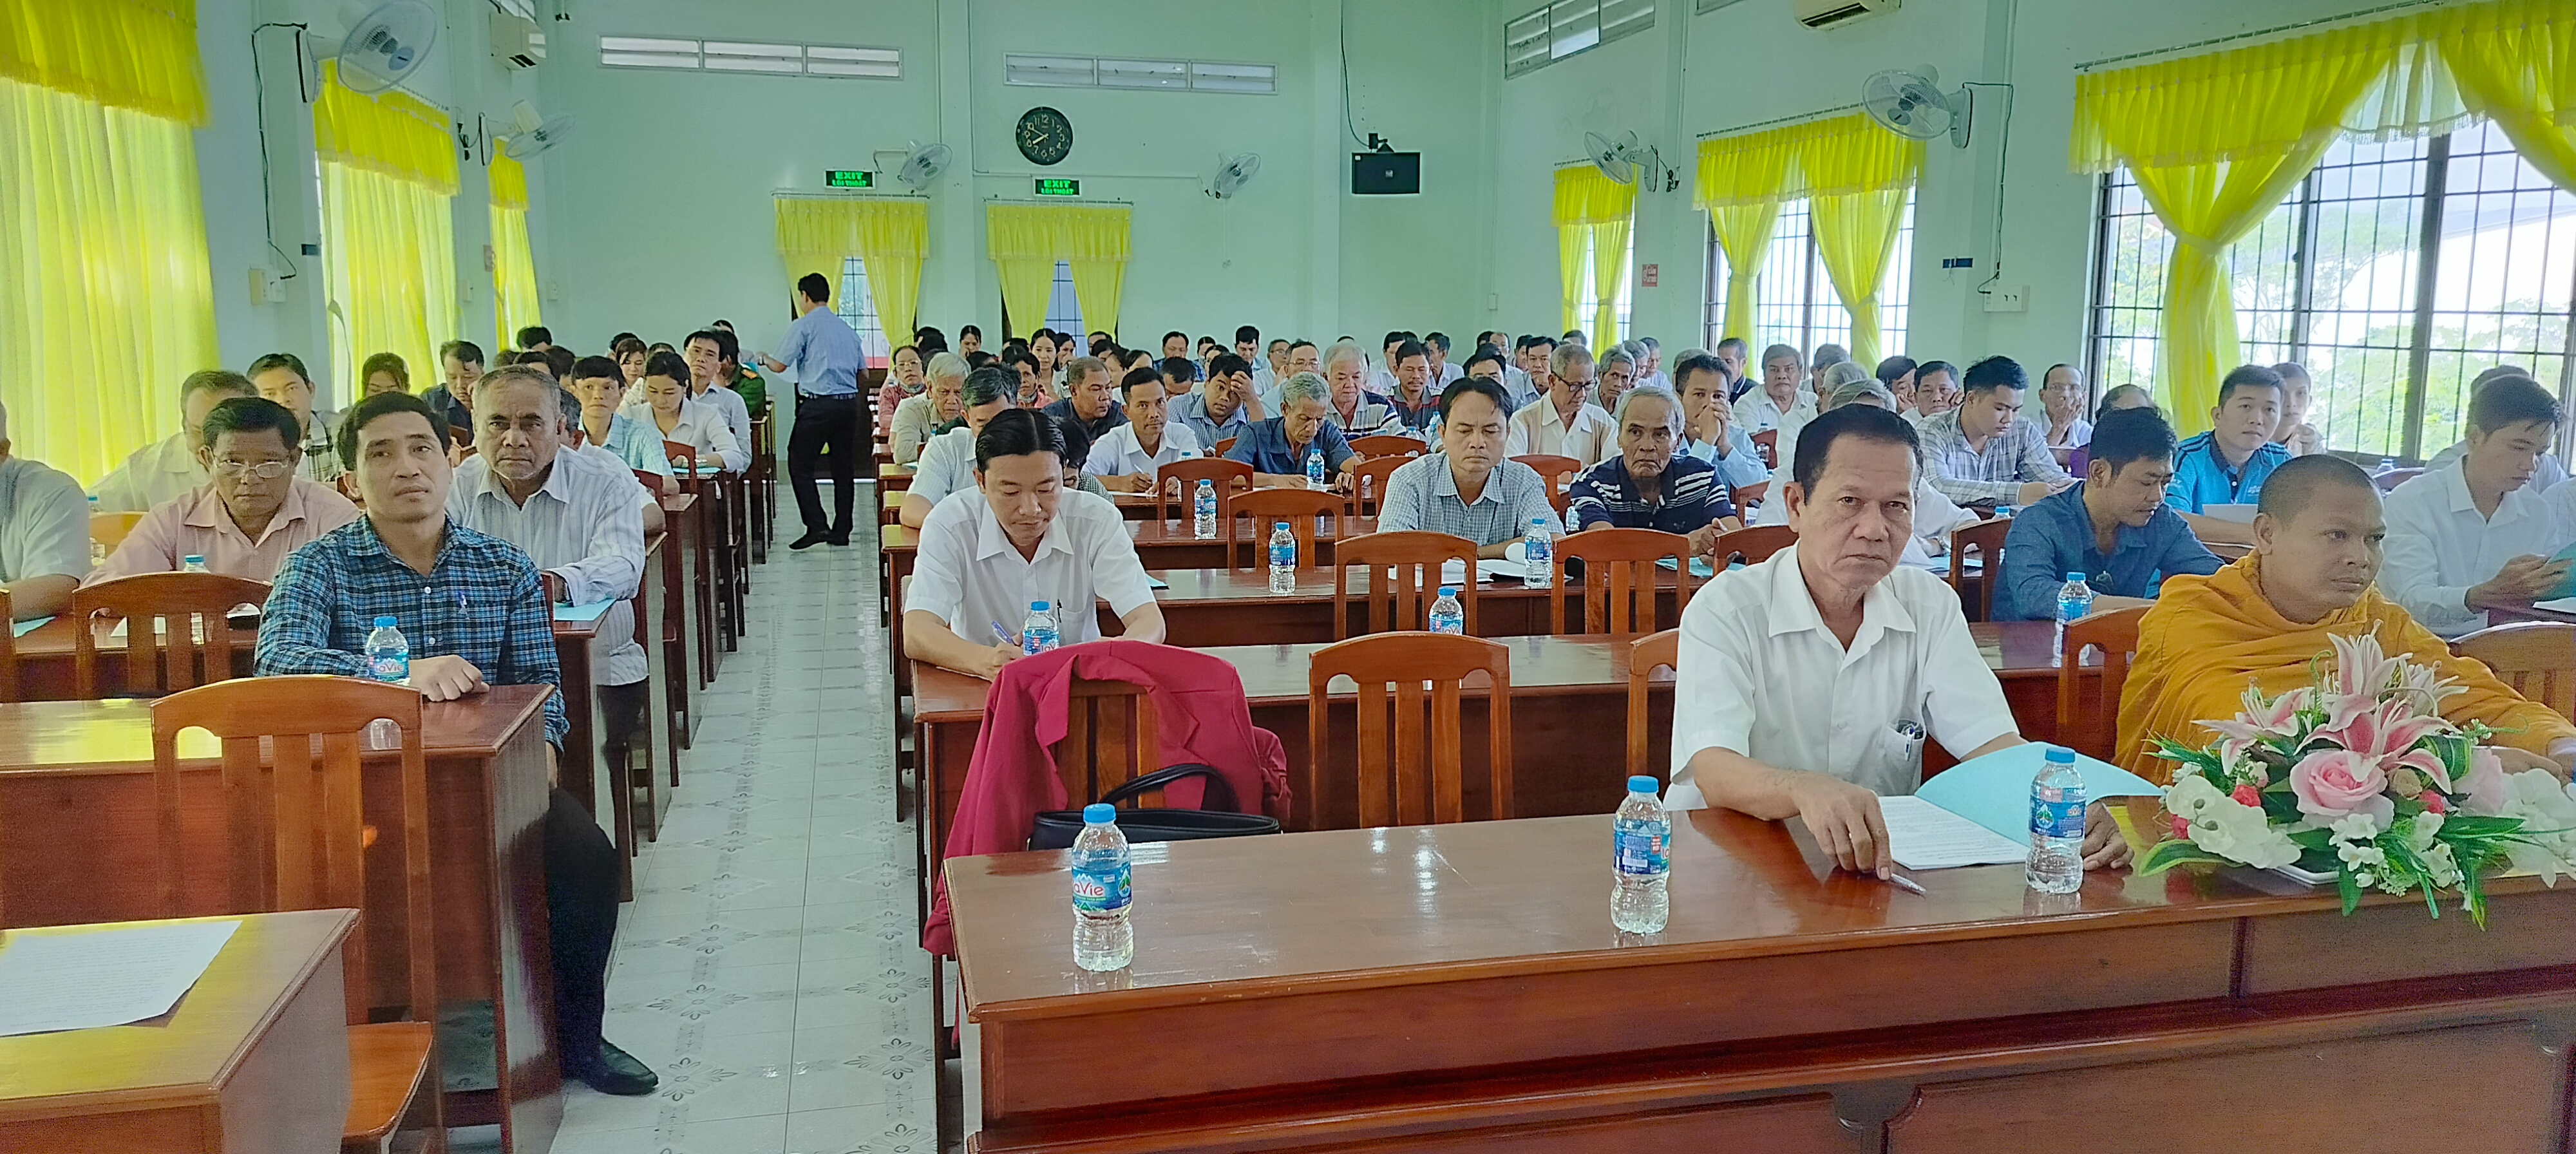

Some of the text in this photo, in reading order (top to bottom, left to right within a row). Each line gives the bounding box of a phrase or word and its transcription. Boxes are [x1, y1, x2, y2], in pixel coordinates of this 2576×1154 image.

[1034, 115, 1040, 126] 11
[1041, 114, 1049, 124] 12
[1056, 125, 1063, 133] 2
[1024, 130, 1031, 138] 9
[1059, 133, 1065, 142] 3
[1026, 139, 1032, 147] 8
[1056, 142, 1062, 150] 4
[1034, 146, 1039, 155] 7
[1041, 149, 1048, 158] 6
[1049, 147, 1056, 155] 5
[835, 171, 863, 180] EXIT
[1044, 180, 1071, 188] EXIT
[1072, 880, 1104, 896] aVie
